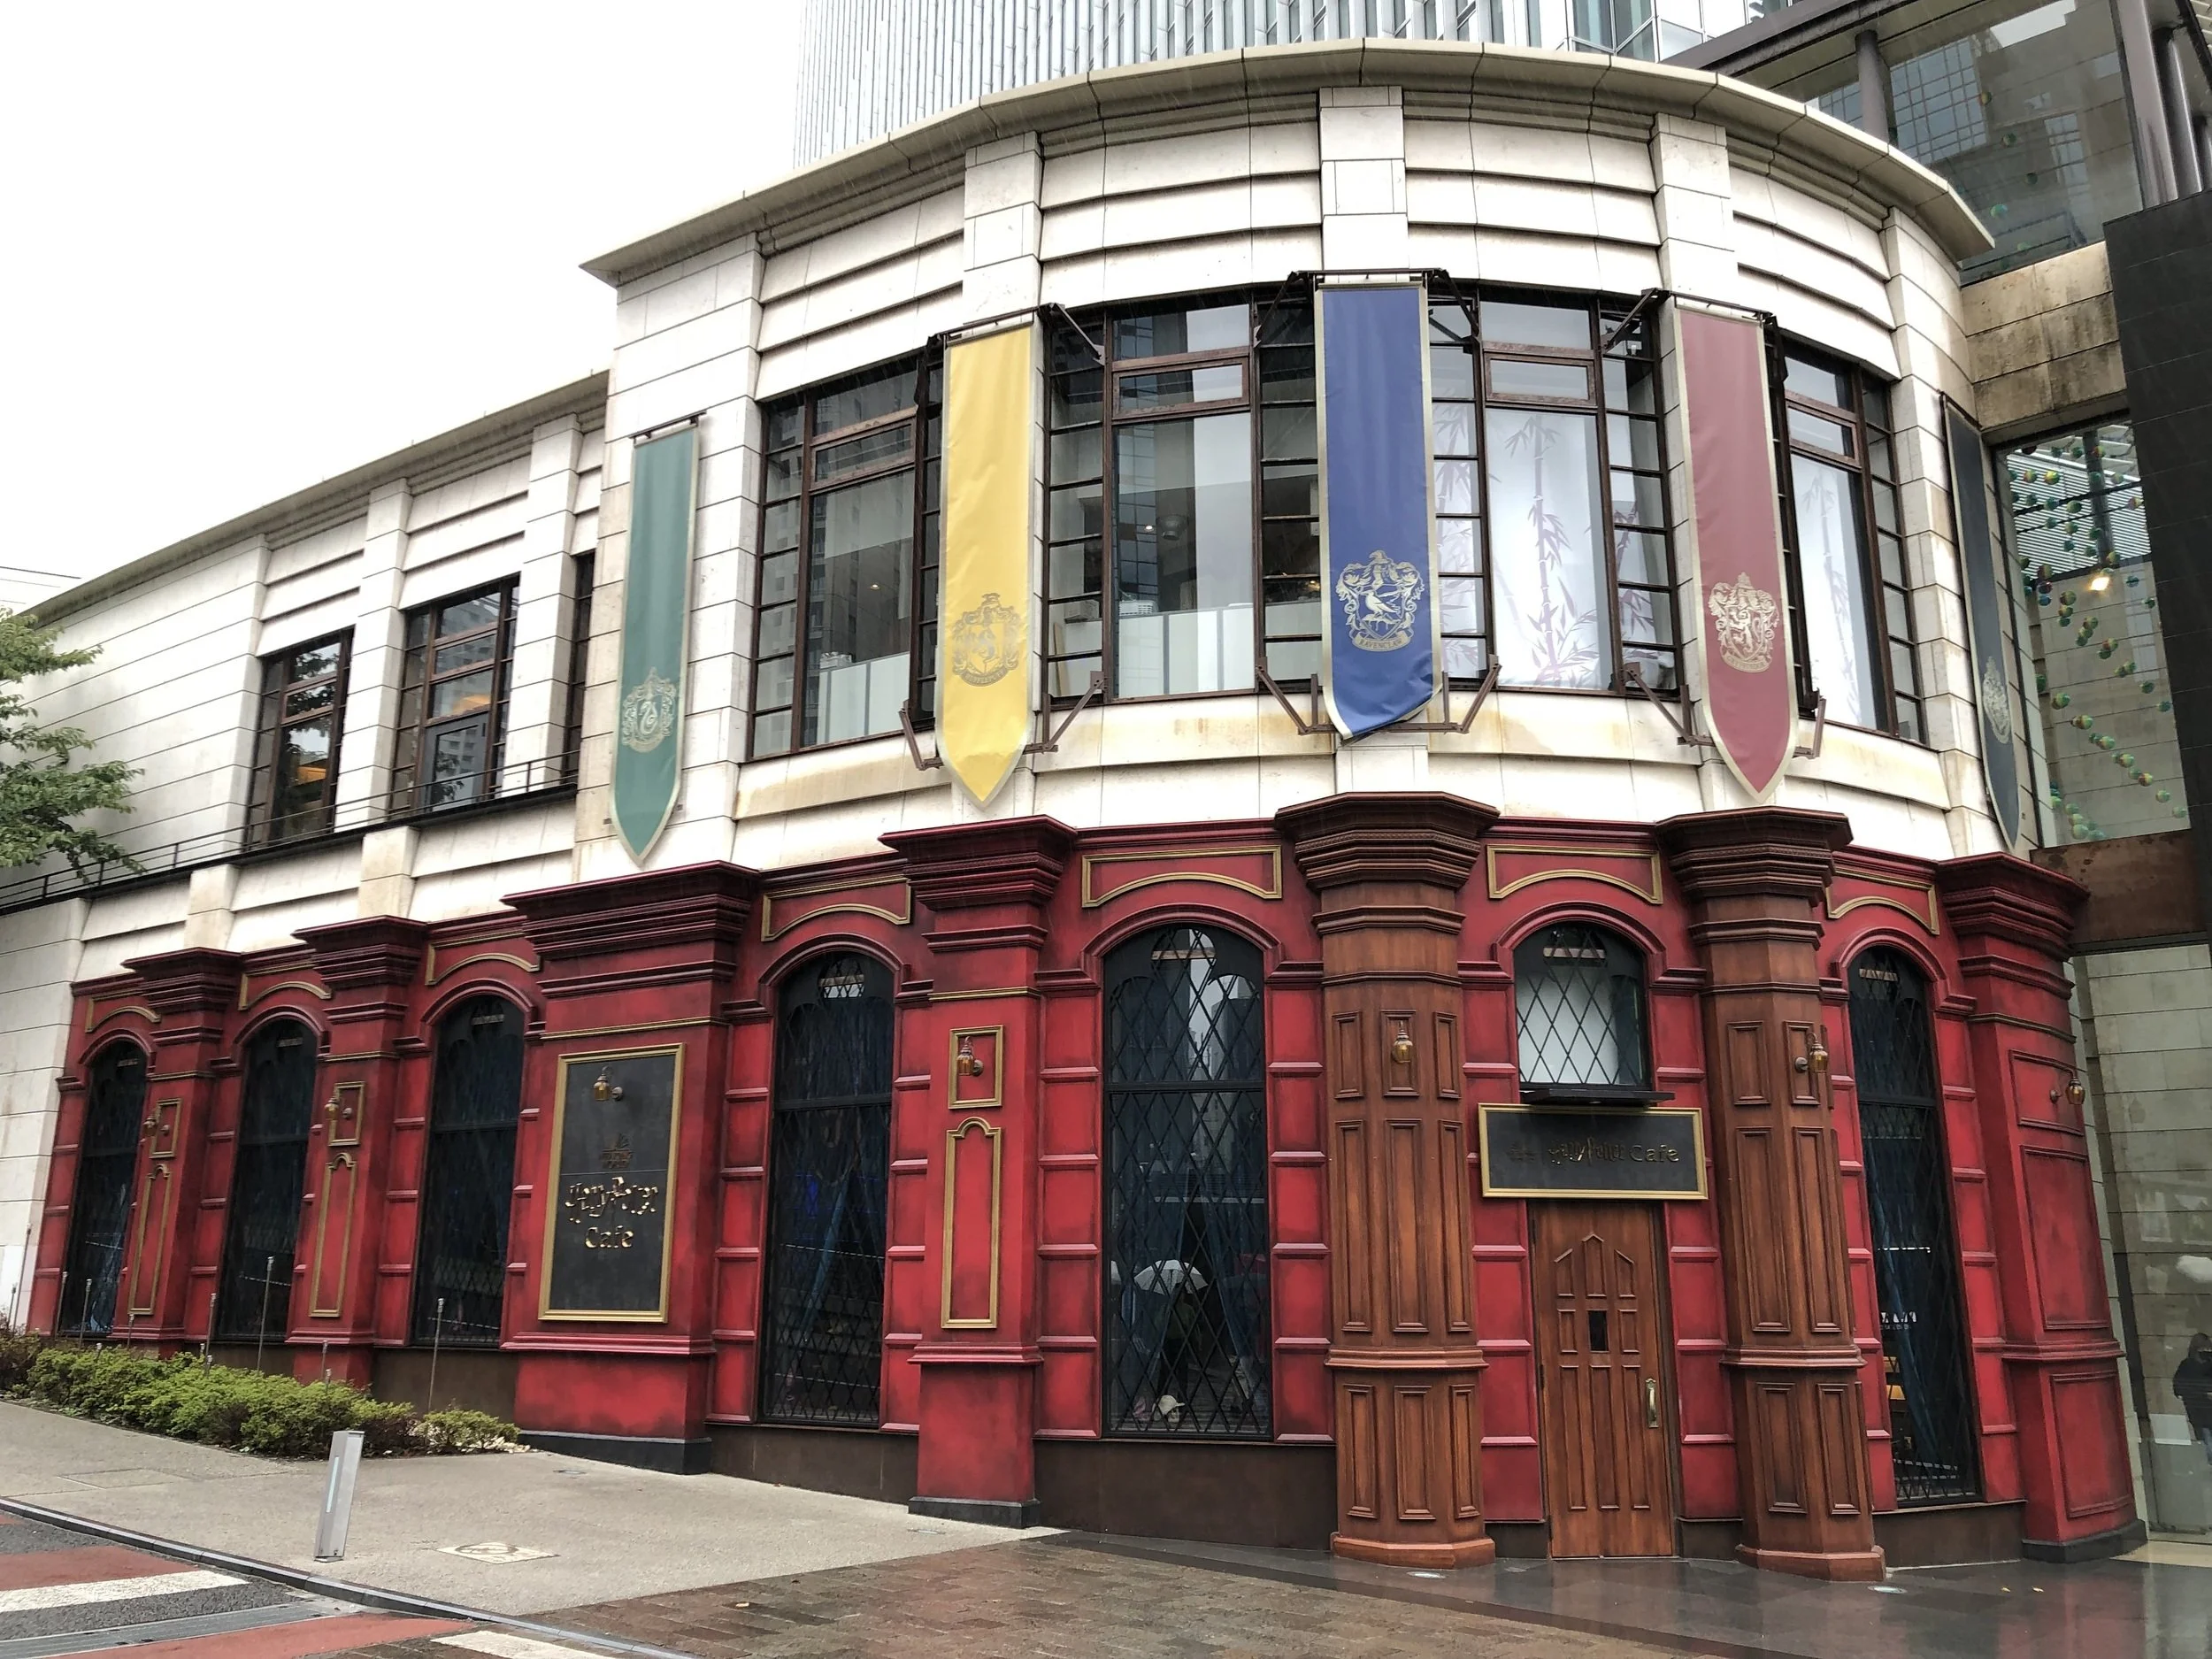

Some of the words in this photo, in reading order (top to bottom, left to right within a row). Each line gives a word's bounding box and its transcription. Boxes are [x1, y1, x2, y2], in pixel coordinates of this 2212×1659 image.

[1358, 638, 1403, 649] RAVENCLAW
[1629, 1143, 1680, 1164] Cafe
[585, 1225, 635, 1249] Cafe
